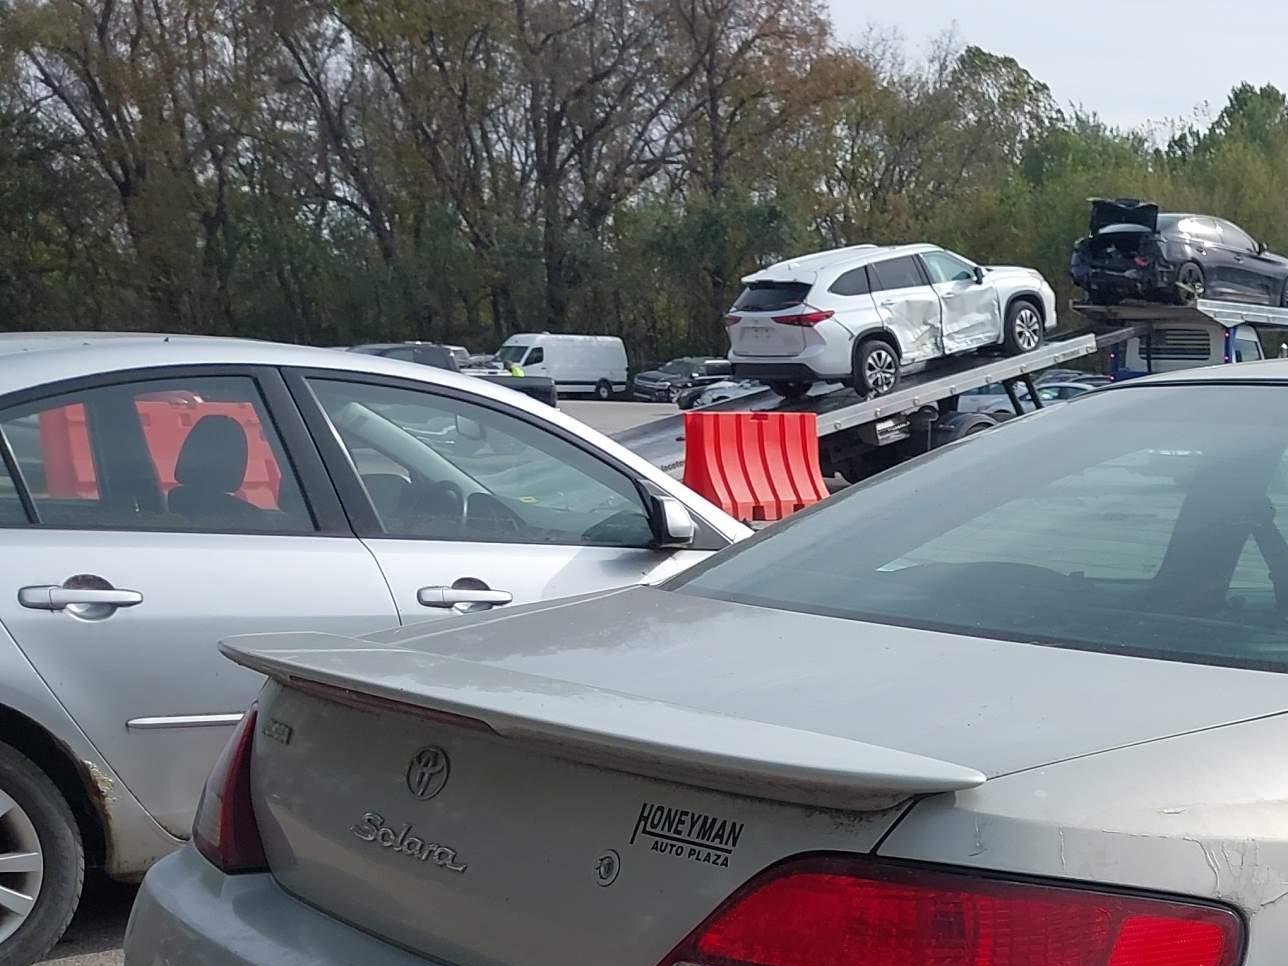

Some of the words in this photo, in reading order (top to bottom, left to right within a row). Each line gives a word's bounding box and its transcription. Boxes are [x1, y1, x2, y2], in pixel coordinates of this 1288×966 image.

[350, 812, 468, 873] Solara
[629, 803, 744, 848] HONEYMAN
[650, 841, 684, 857] AUTO
[687, 848, 730, 868] PLAZA
